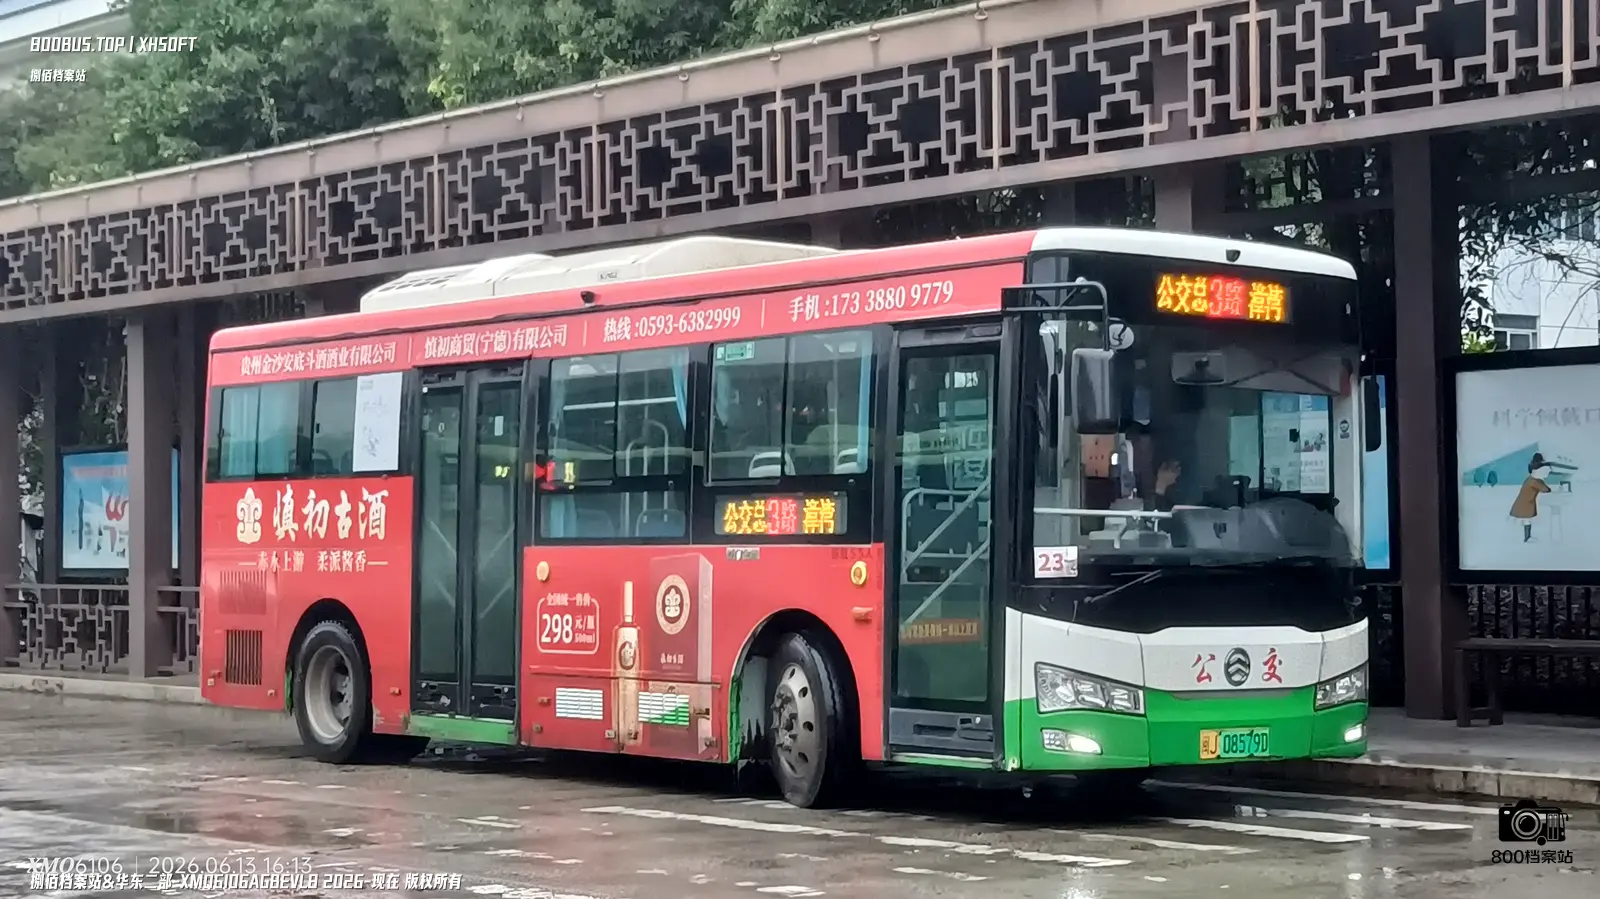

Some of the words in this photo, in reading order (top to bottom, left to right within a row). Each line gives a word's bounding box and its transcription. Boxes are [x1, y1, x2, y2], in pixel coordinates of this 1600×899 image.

[865, 285, 906, 312] 3880
[910, 280, 955, 306] 9779
[272, 483, 389, 542] 慎初古酒
[257, 551, 305, 573] 赤水上游
[1038, 553, 1064, 571] 23
[541, 613, 573, 643] 298
